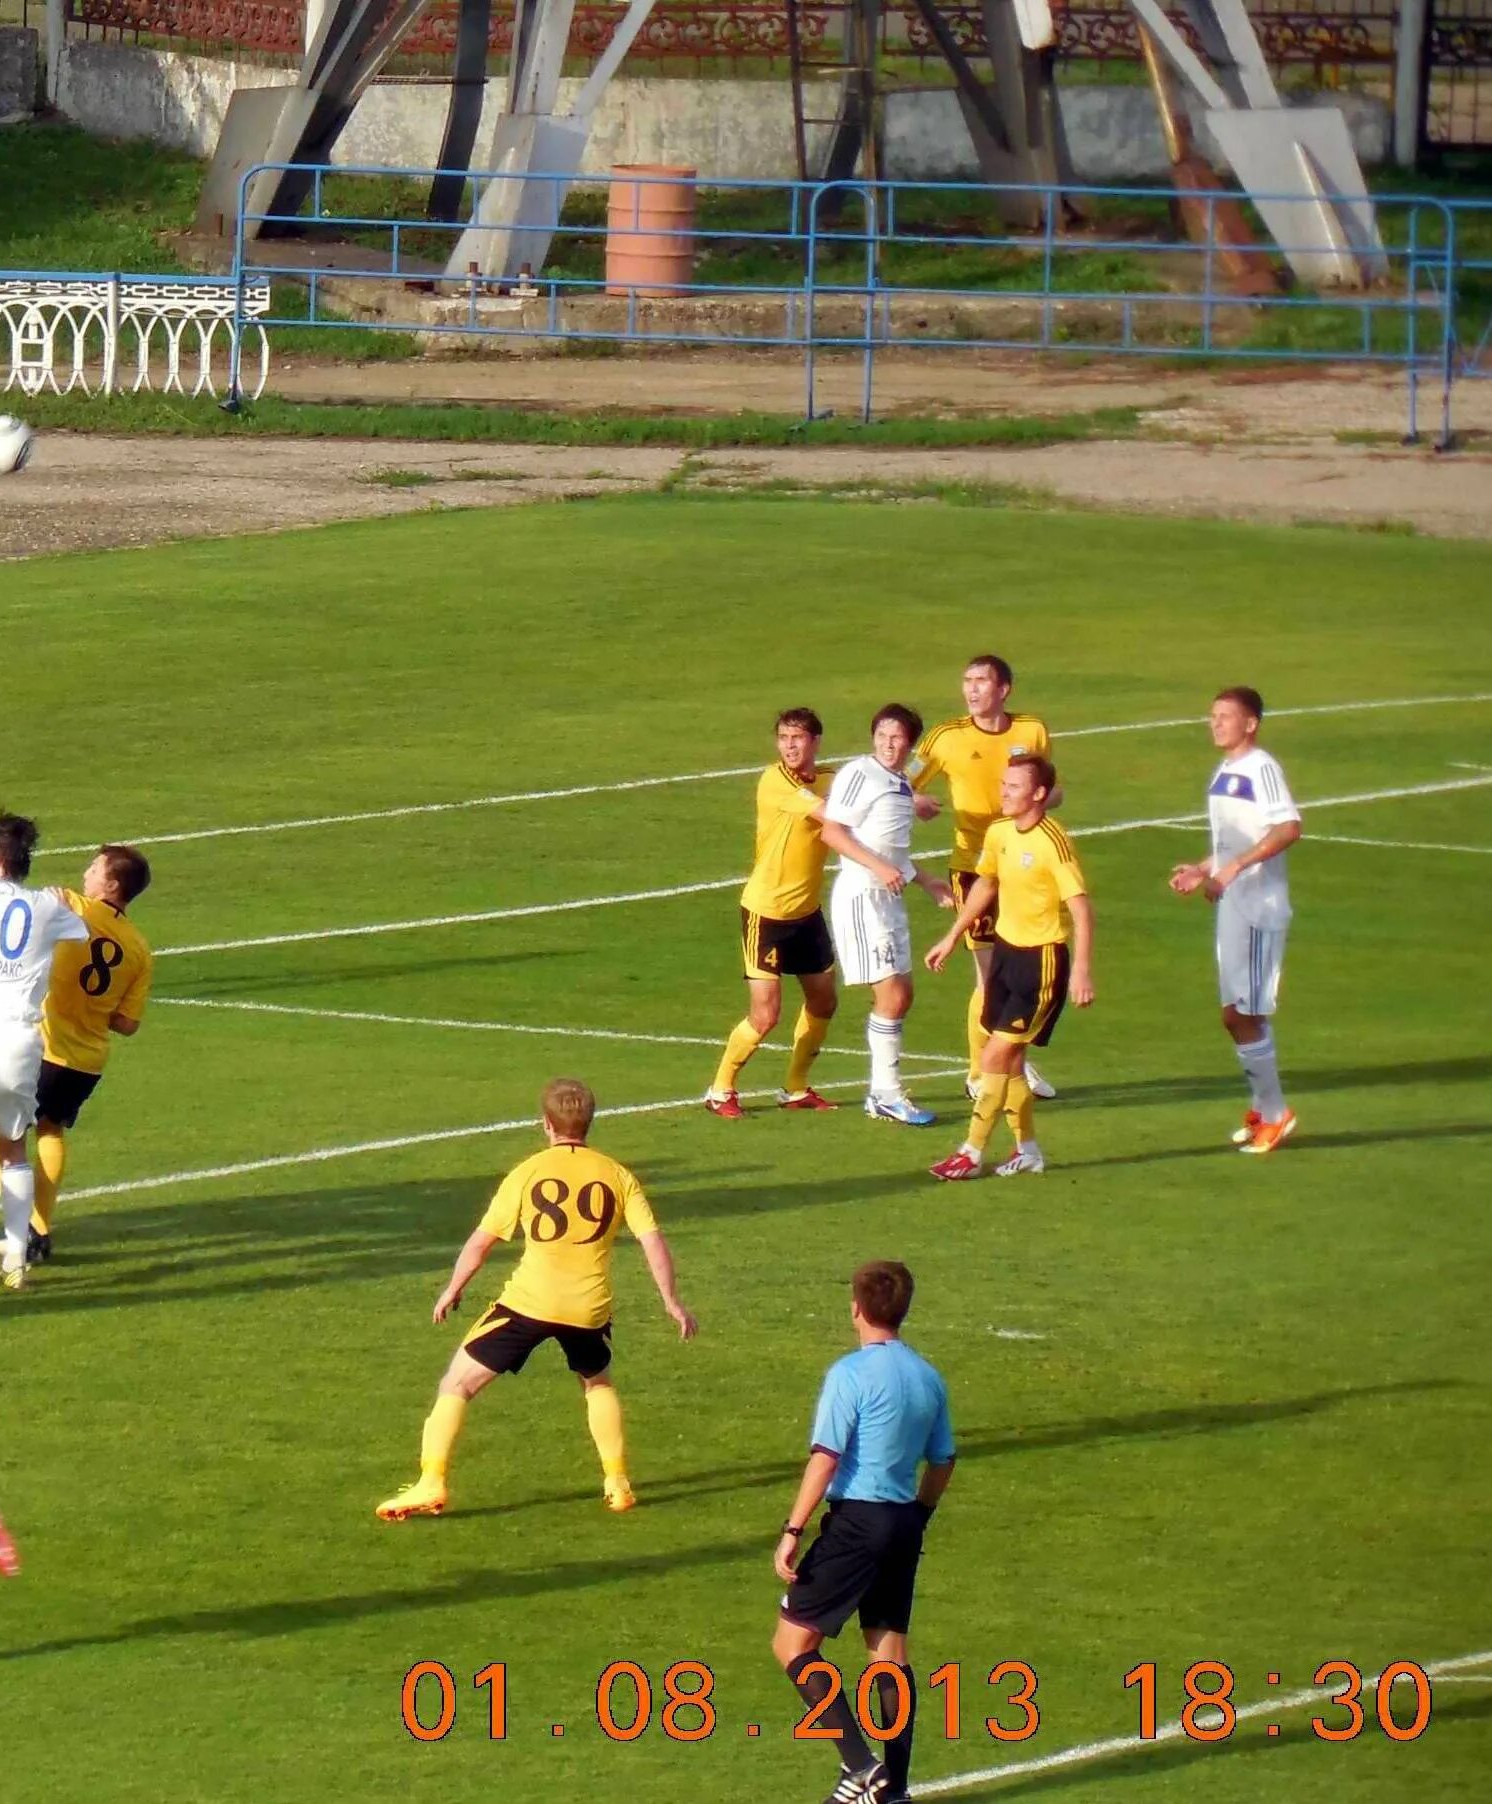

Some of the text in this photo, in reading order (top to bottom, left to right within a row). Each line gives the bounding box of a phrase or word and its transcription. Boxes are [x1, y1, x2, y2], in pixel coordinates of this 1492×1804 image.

[79, 937, 124, 996] 8
[764, 946, 779, 968] 4
[530, 1178, 616, 1245] 89
